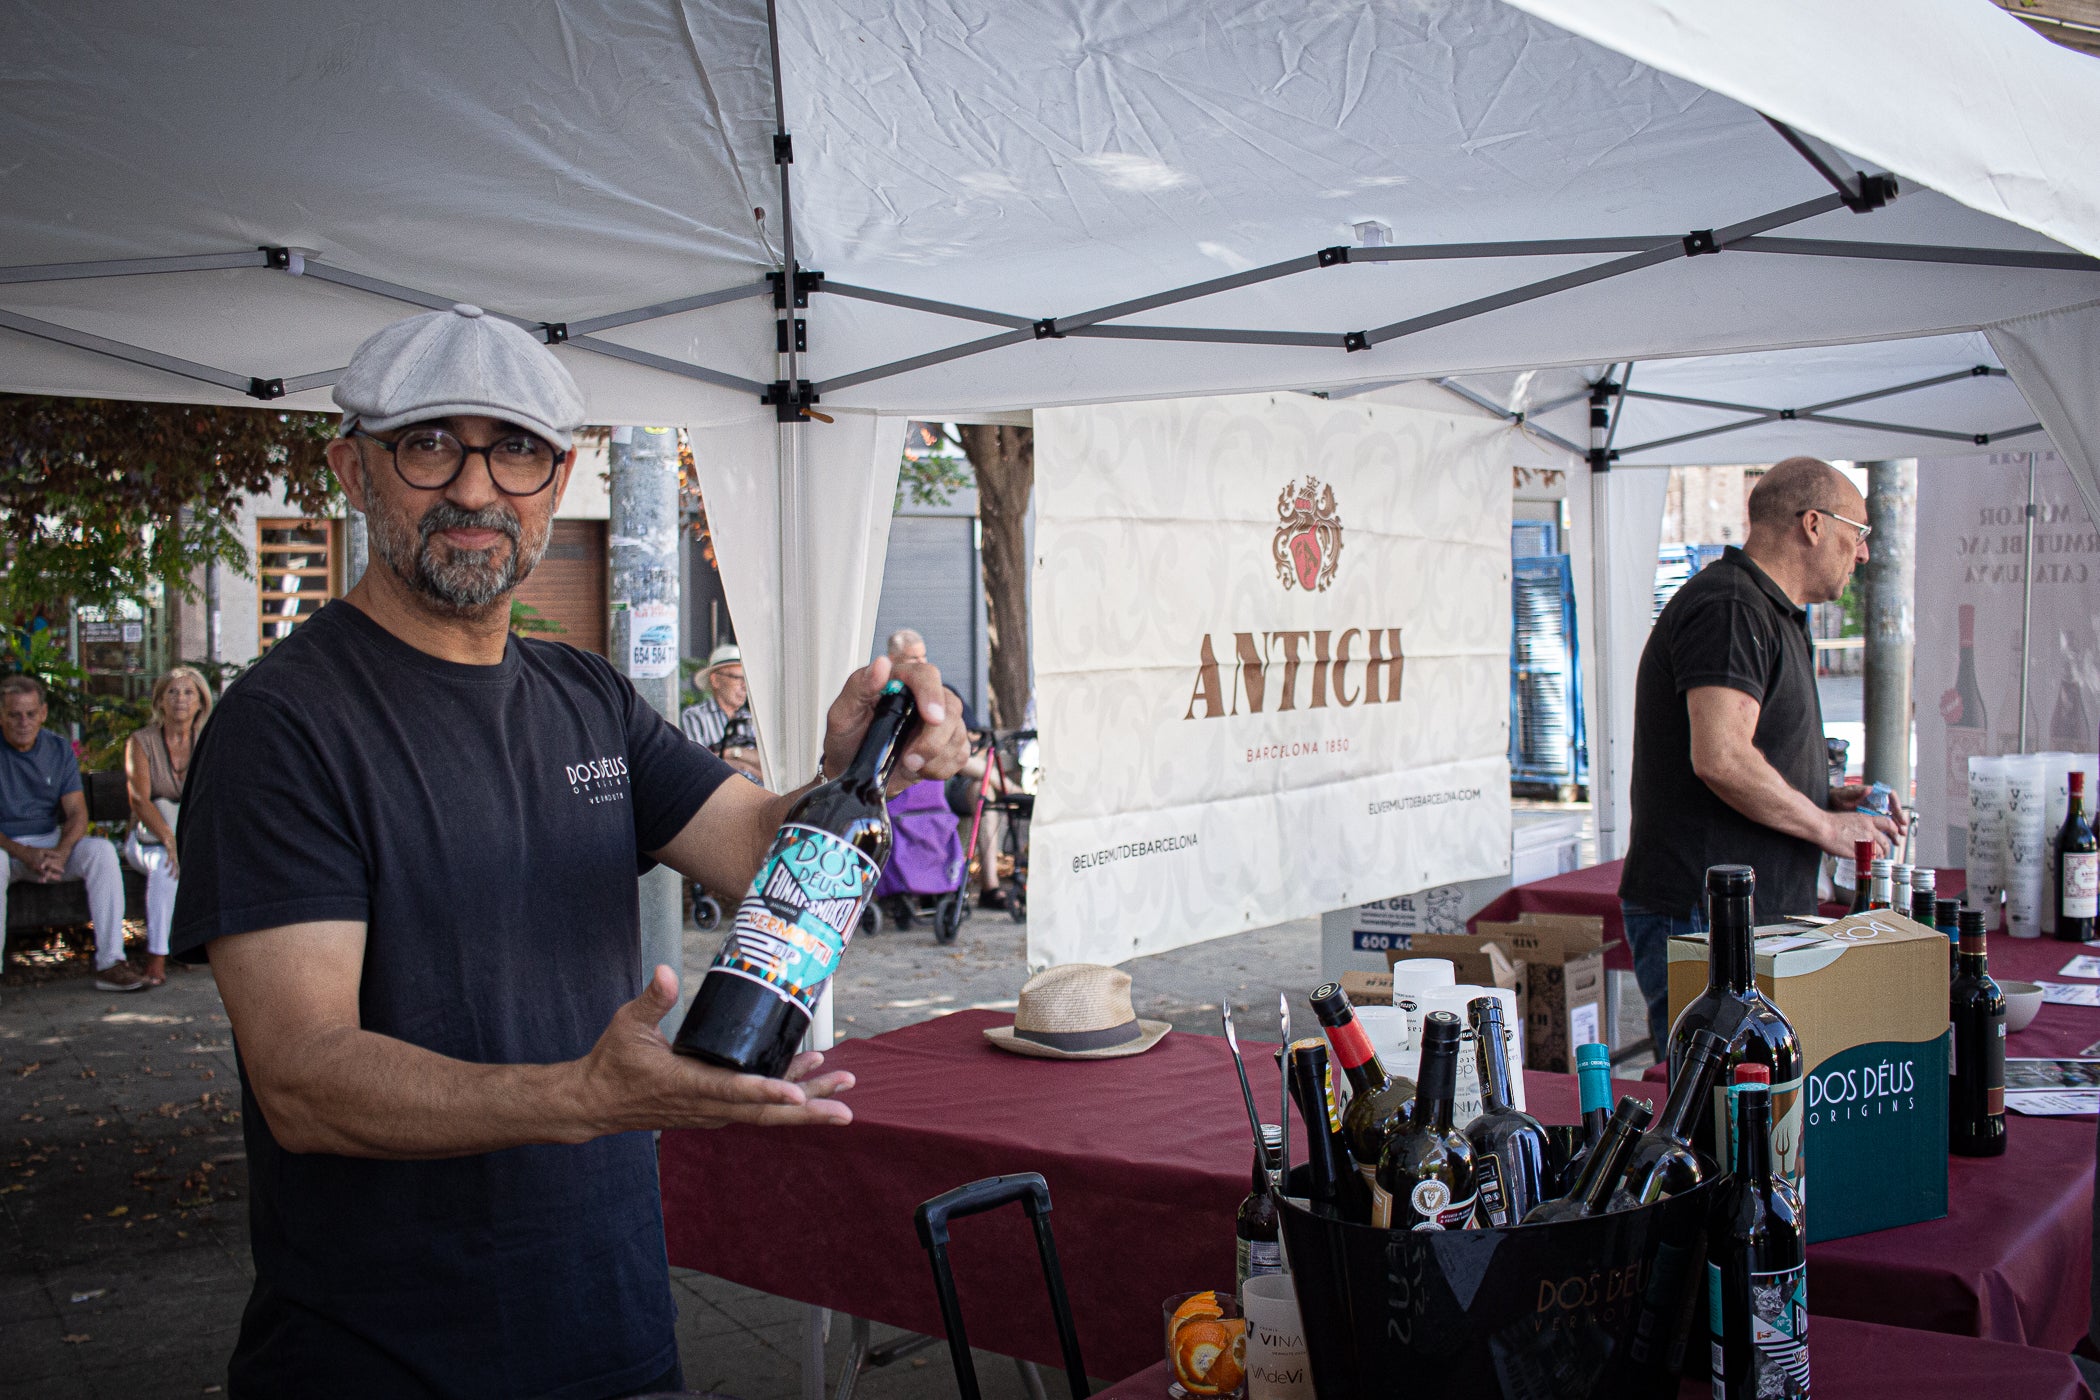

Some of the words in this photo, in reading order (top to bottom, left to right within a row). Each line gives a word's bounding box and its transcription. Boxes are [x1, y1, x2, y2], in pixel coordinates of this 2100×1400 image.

[1183, 627, 1405, 721] ANTICH
[1247, 742, 1319, 763] BARCELONA
[1325, 738, 1350, 753] 1850
[566, 760, 601, 785] DOS
[796, 839, 861, 888] DOS
[1072, 833, 1198, 873] @ELVERMUTDEBARCELONA
[1389, 897, 1416, 912] GEL
[1361, 935, 1389, 950] 600
[1809, 1069, 1857, 1107] DOS
[1863, 1058, 1915, 1099] DÉUS
[1809, 1097, 1915, 1126] ORIGINS
[1536, 1272, 1600, 1313] DOS
